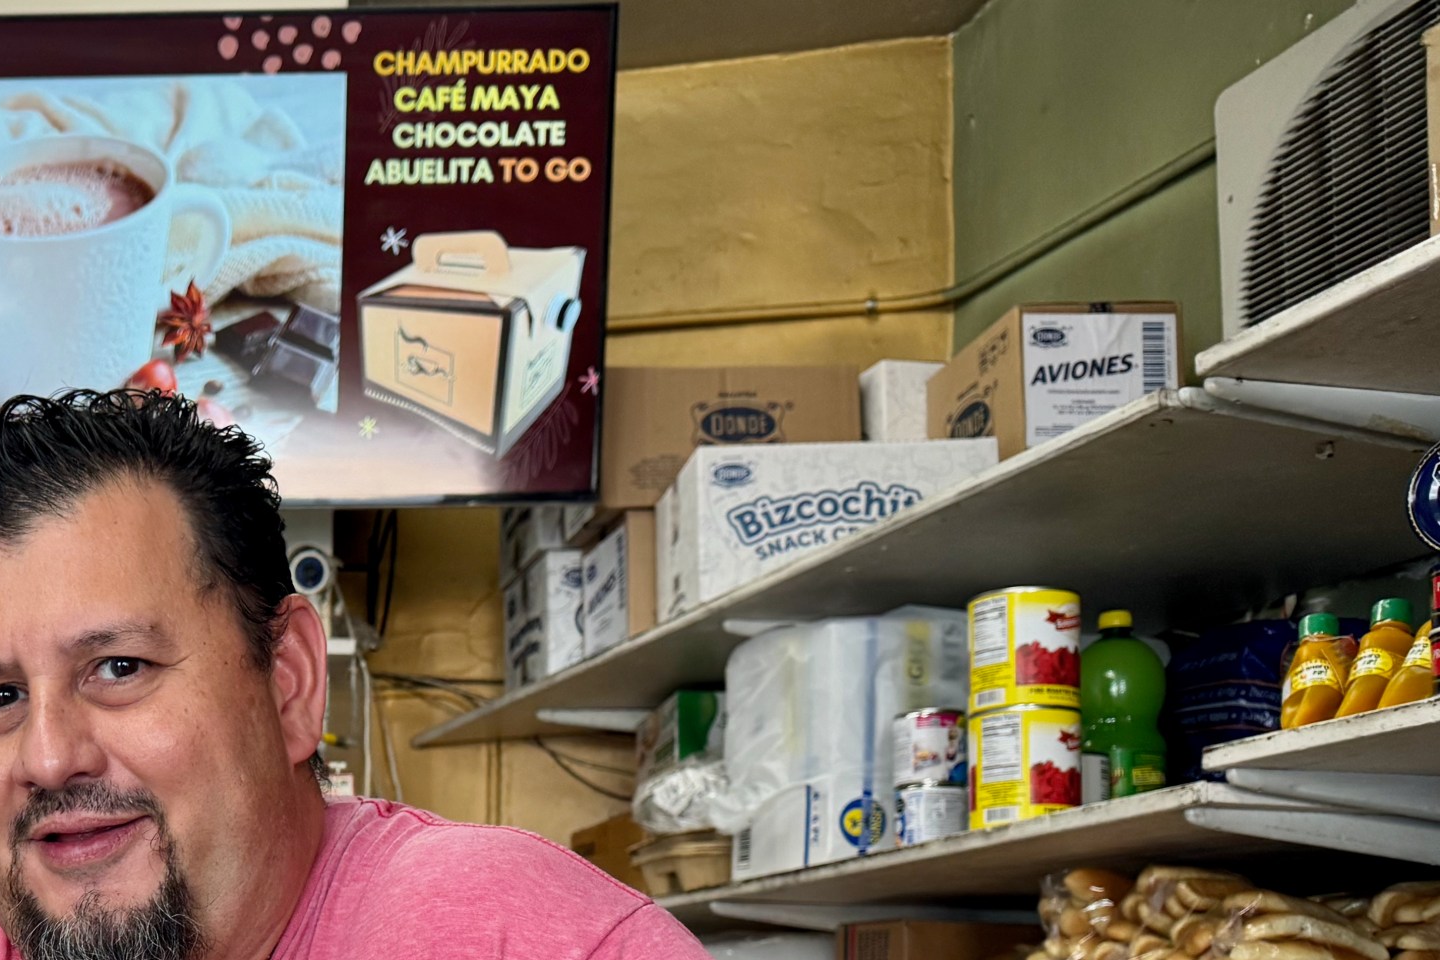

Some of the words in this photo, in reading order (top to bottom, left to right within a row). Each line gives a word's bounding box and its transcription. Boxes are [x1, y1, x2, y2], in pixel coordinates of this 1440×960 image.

[373, 48, 590, 76] CHAMPURRADO
[393, 77, 467, 112] CAFÉ
[471, 84, 560, 110] MAYA
[392, 120, 566, 149] CHOCOLATE
[364, 157, 494, 185] ABUELITA
[498, 157, 539, 183] TO
[544, 157, 592, 183] GO
[1031, 354, 1134, 386] AVIONES
[755, 528, 827, 560] SNACK
